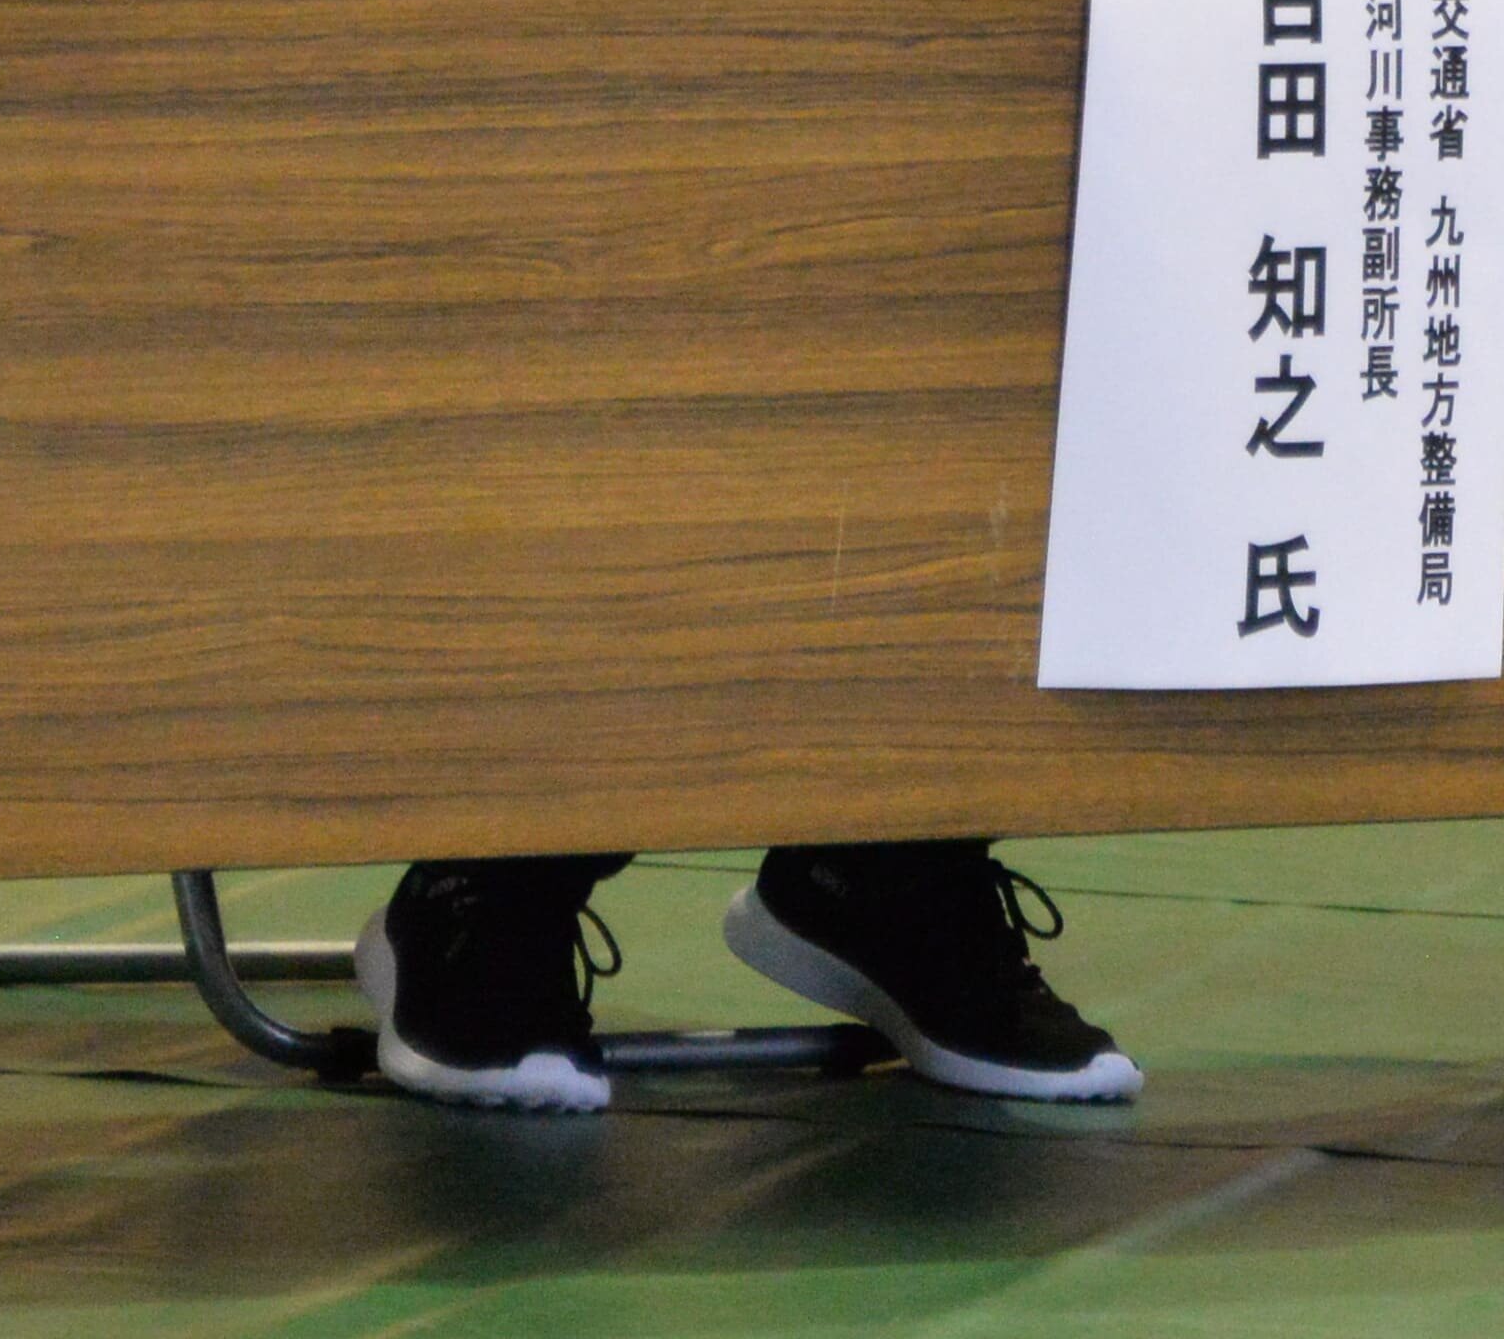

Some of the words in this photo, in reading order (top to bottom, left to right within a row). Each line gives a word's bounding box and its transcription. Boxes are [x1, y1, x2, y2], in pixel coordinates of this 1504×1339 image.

[1246, 233, 1328, 459] 知之
[1417, 194, 1464, 606] 九州地方整備局
[1237, 534, 1321, 638] 氏
